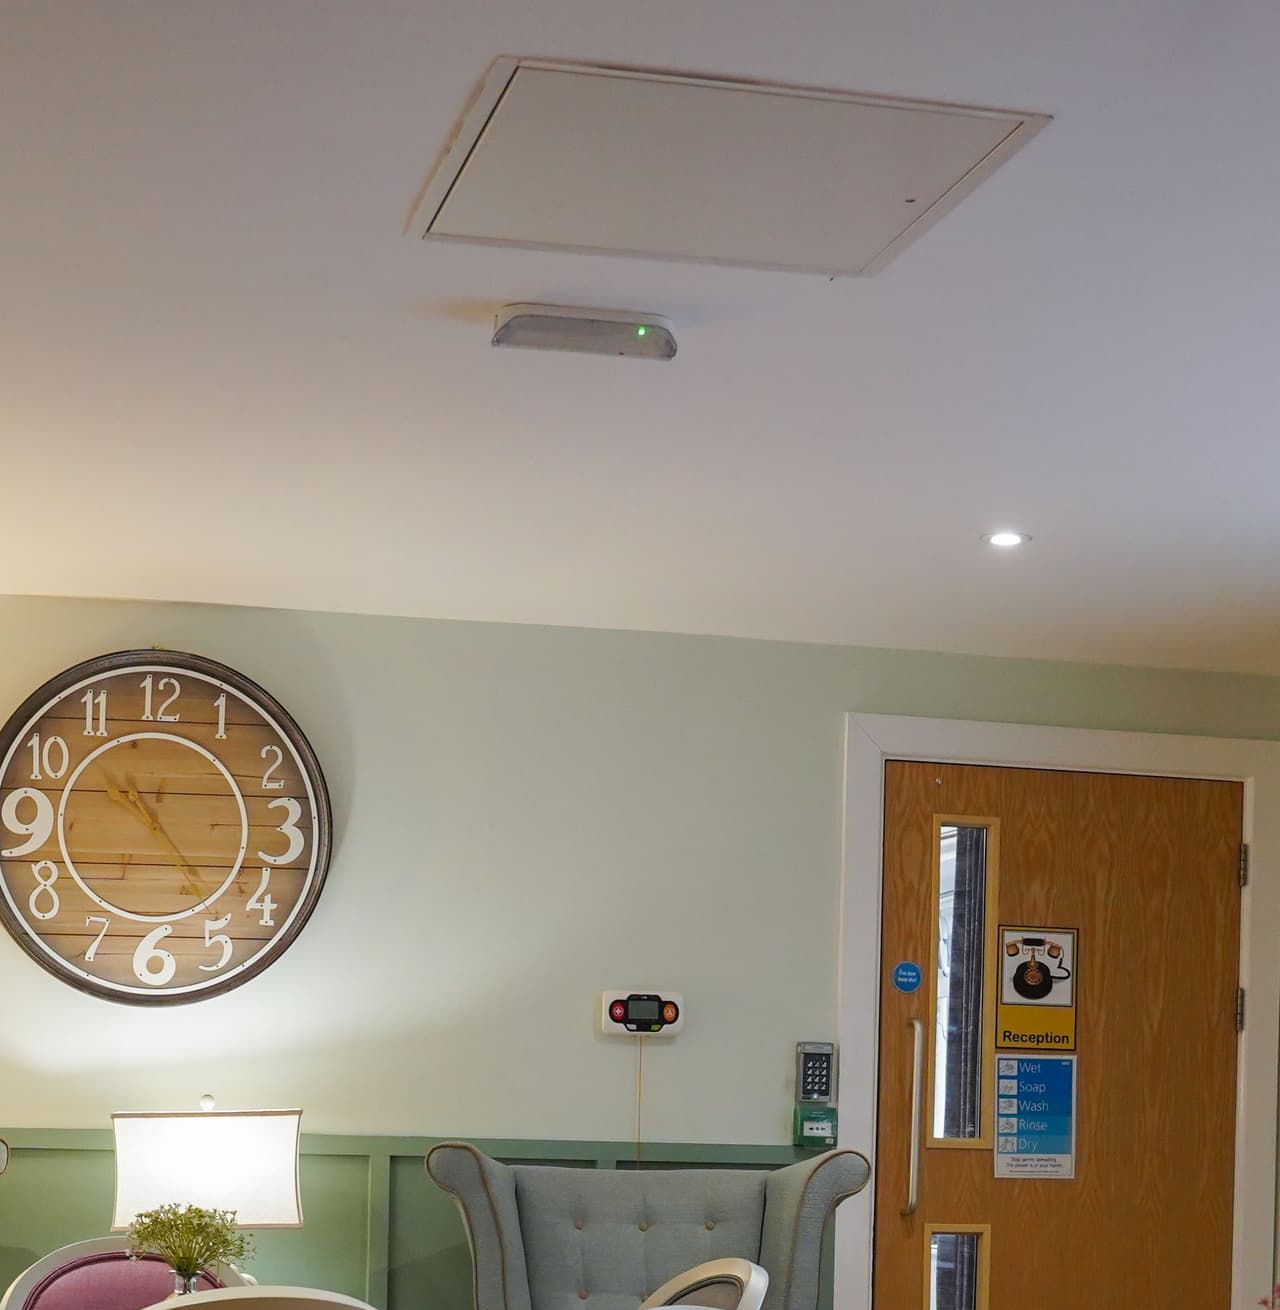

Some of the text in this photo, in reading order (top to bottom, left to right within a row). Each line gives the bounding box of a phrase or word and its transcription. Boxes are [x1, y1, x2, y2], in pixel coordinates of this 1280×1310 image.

[81, 689, 108, 736] 11
[140, 674, 181, 721] 12
[213, 693, 227, 739] 1
[27, 732, 69, 780] 10
[260, 745, 285, 789] 2
[1, 787, 55, 857] 9
[257, 797, 305, 865] 3
[29, 860, 60, 920] 8
[246, 867, 278, 926] 4
[85, 916, 111, 962] 7
[133, 925, 177, 986] 6
[198, 913, 233, 971] 5
[1002, 1030, 1069, 1045] Reception
[1019, 1062, 1041, 1073] Wet
[1019, 1080, 1047, 1094] Soap
[1019, 1100, 1049, 1112] Wash
[1019, 1119, 1048, 1131] Rinse
[1019, 1138, 1039, 1153] Dry
